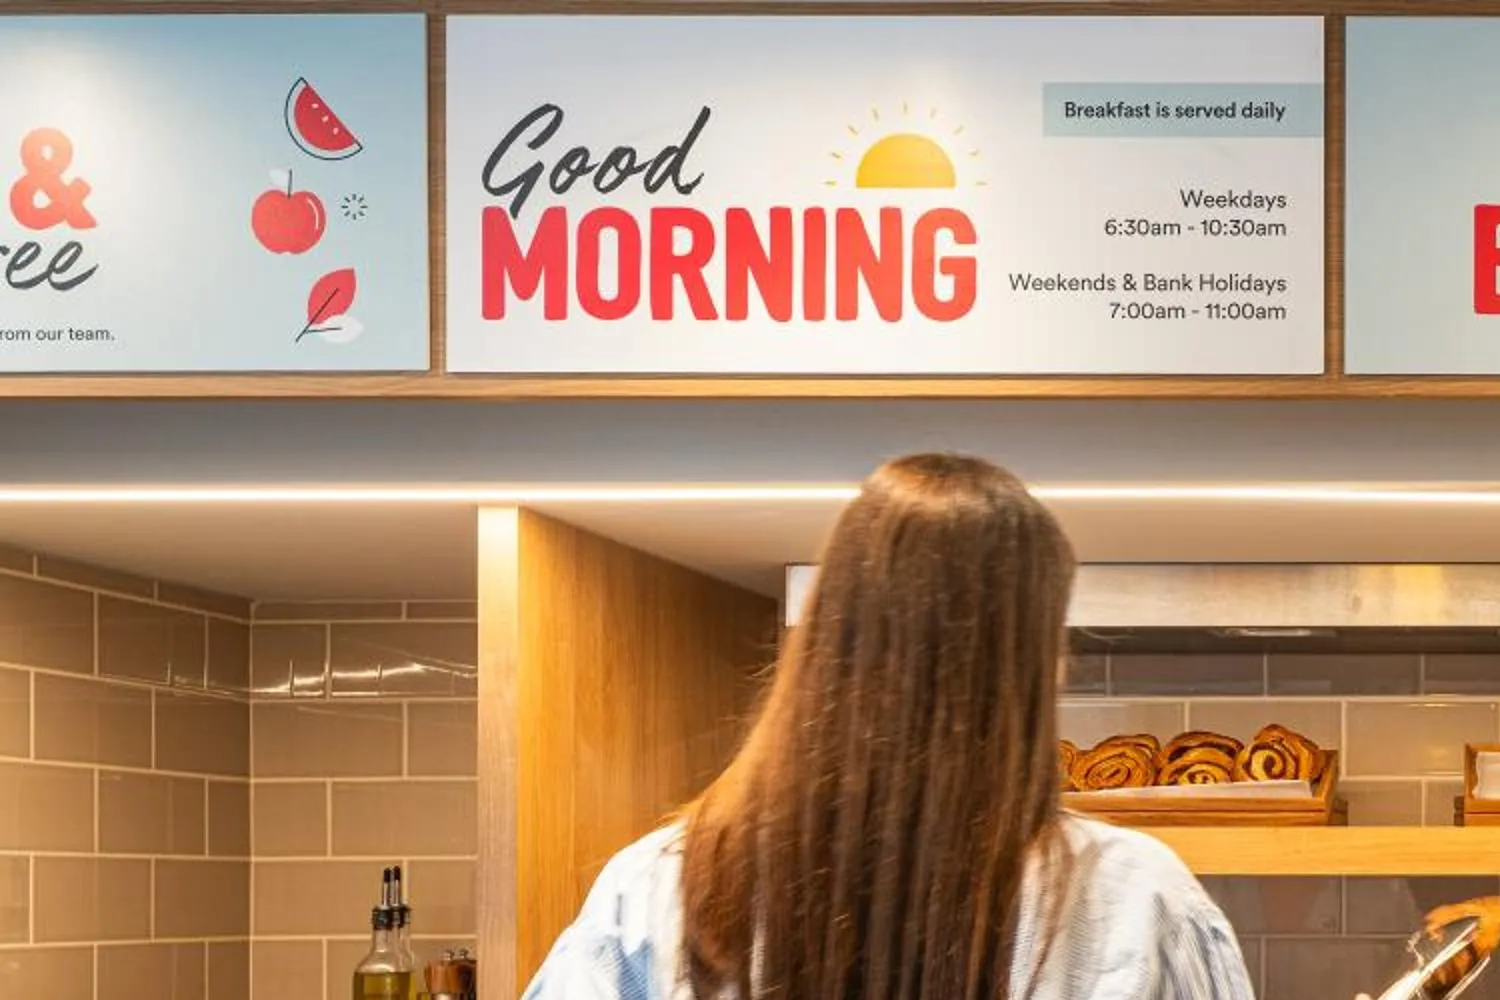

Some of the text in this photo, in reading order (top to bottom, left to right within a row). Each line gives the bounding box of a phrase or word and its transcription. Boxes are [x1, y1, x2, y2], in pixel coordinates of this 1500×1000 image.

[1064, 101, 1287, 123] Breakfast is served daily
[481, 103, 712, 219] Good
[9, 126, 99, 231] &
[1180, 189, 1288, 213] Weekdays
[1104, 218, 1182, 238] 6:30am
[1200, 218, 1287, 238] 10:30am
[481, 205, 977, 324] MORNING
[1008, 273, 1287, 297] Weekends & Bank Holidays
[1109, 302, 1186, 321] 7:00am
[1204, 302, 1287, 321] 11:00am
[35, 329, 65, 341] our
[67, 327, 115, 341] team.
